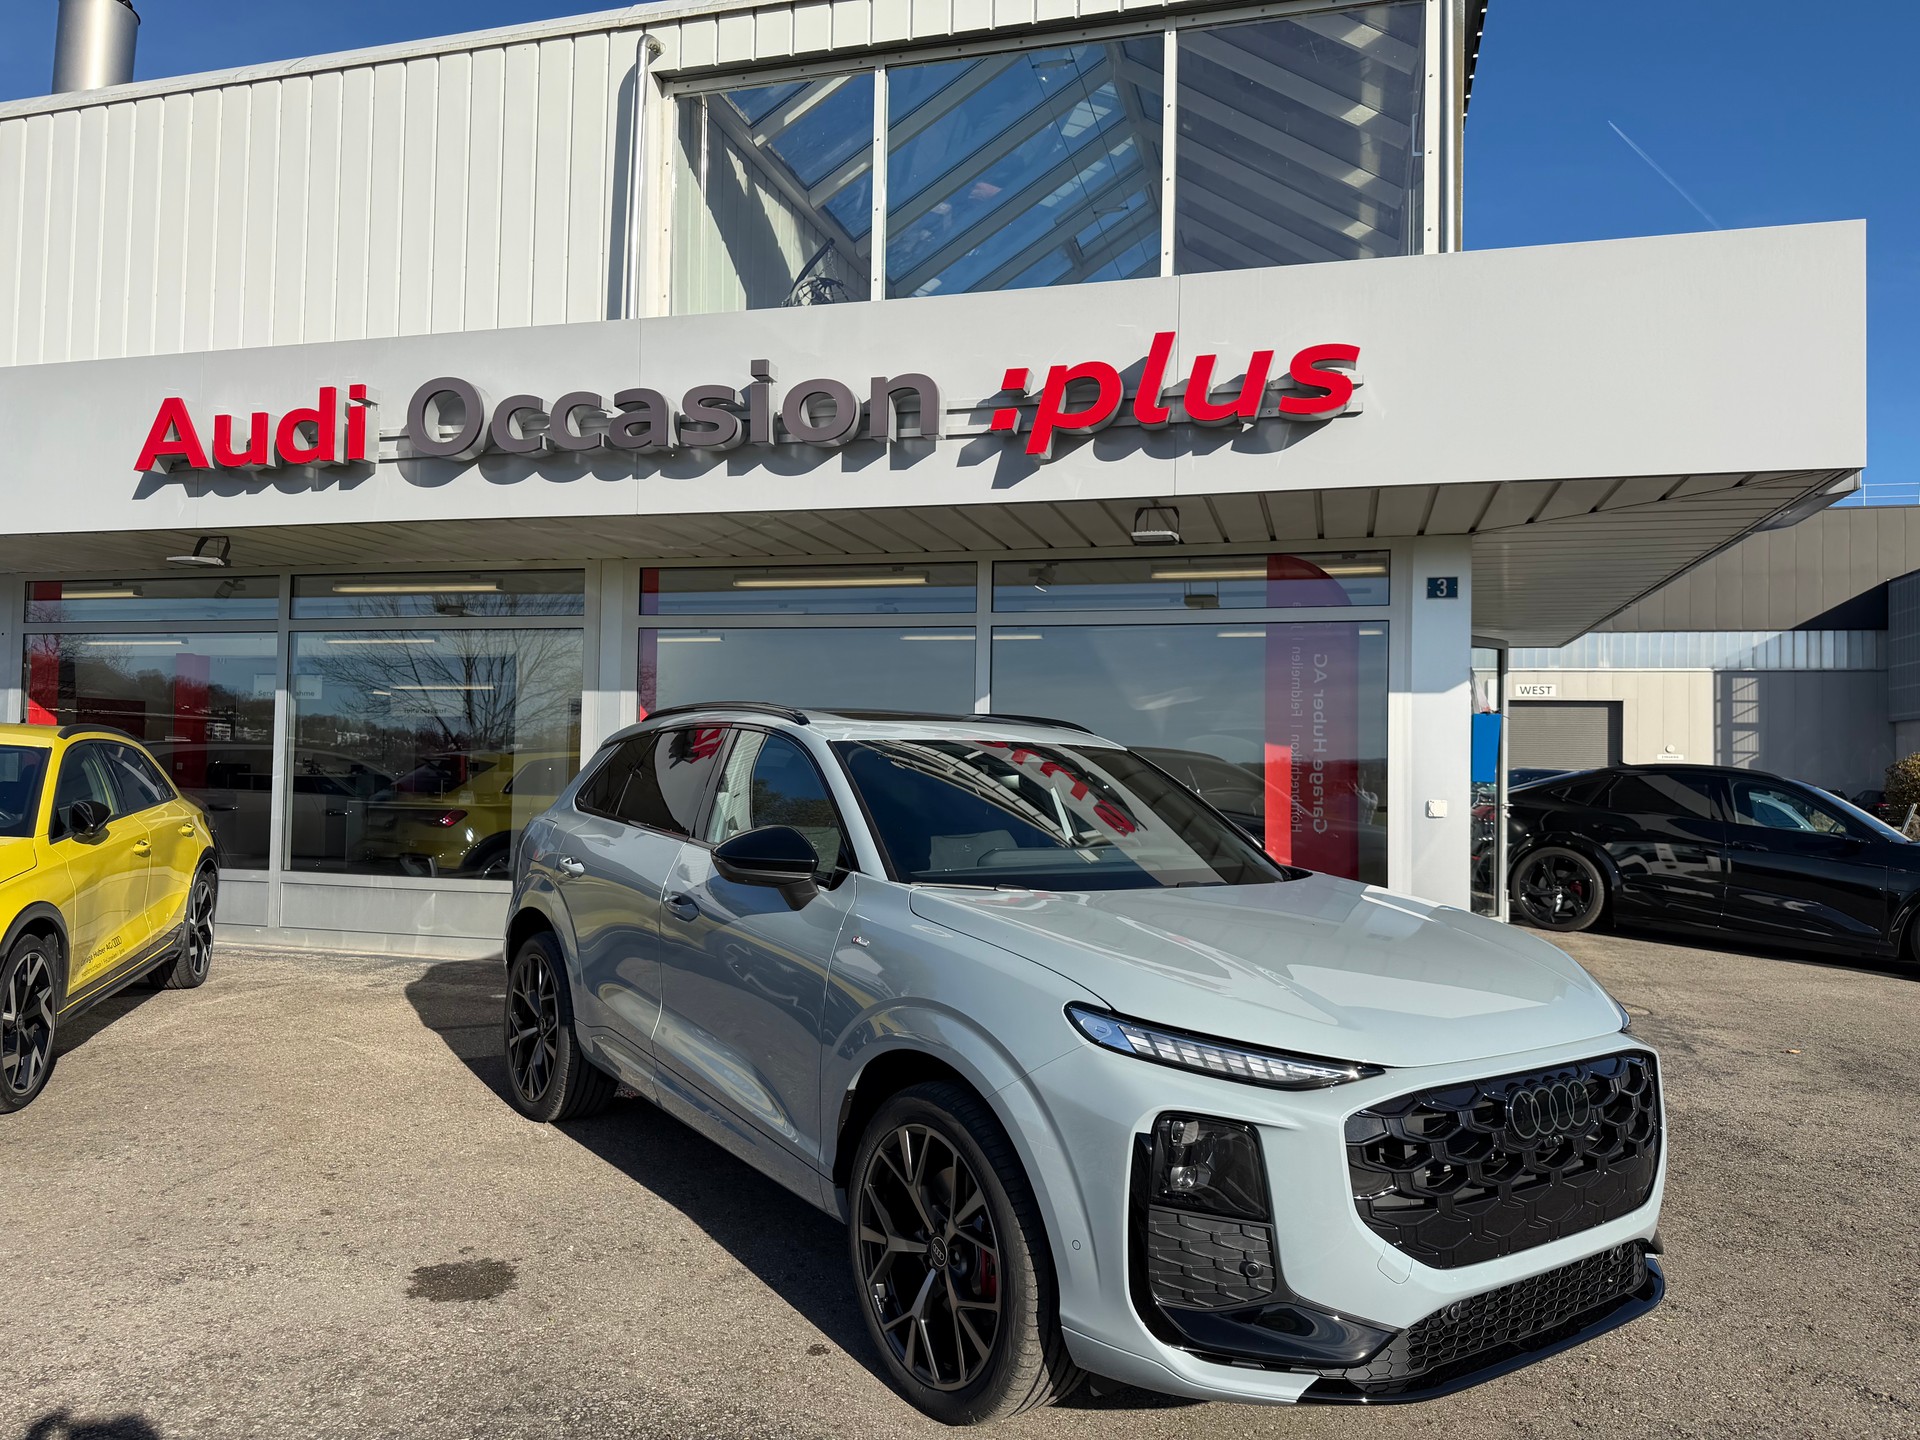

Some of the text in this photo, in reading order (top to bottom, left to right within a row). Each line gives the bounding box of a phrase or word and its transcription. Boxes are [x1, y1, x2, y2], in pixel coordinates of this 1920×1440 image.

[133, 331, 1361, 473] Audi Occasion :plus
[1436, 578, 1447, 597] 3
[1519, 685, 1553, 695] WEST
